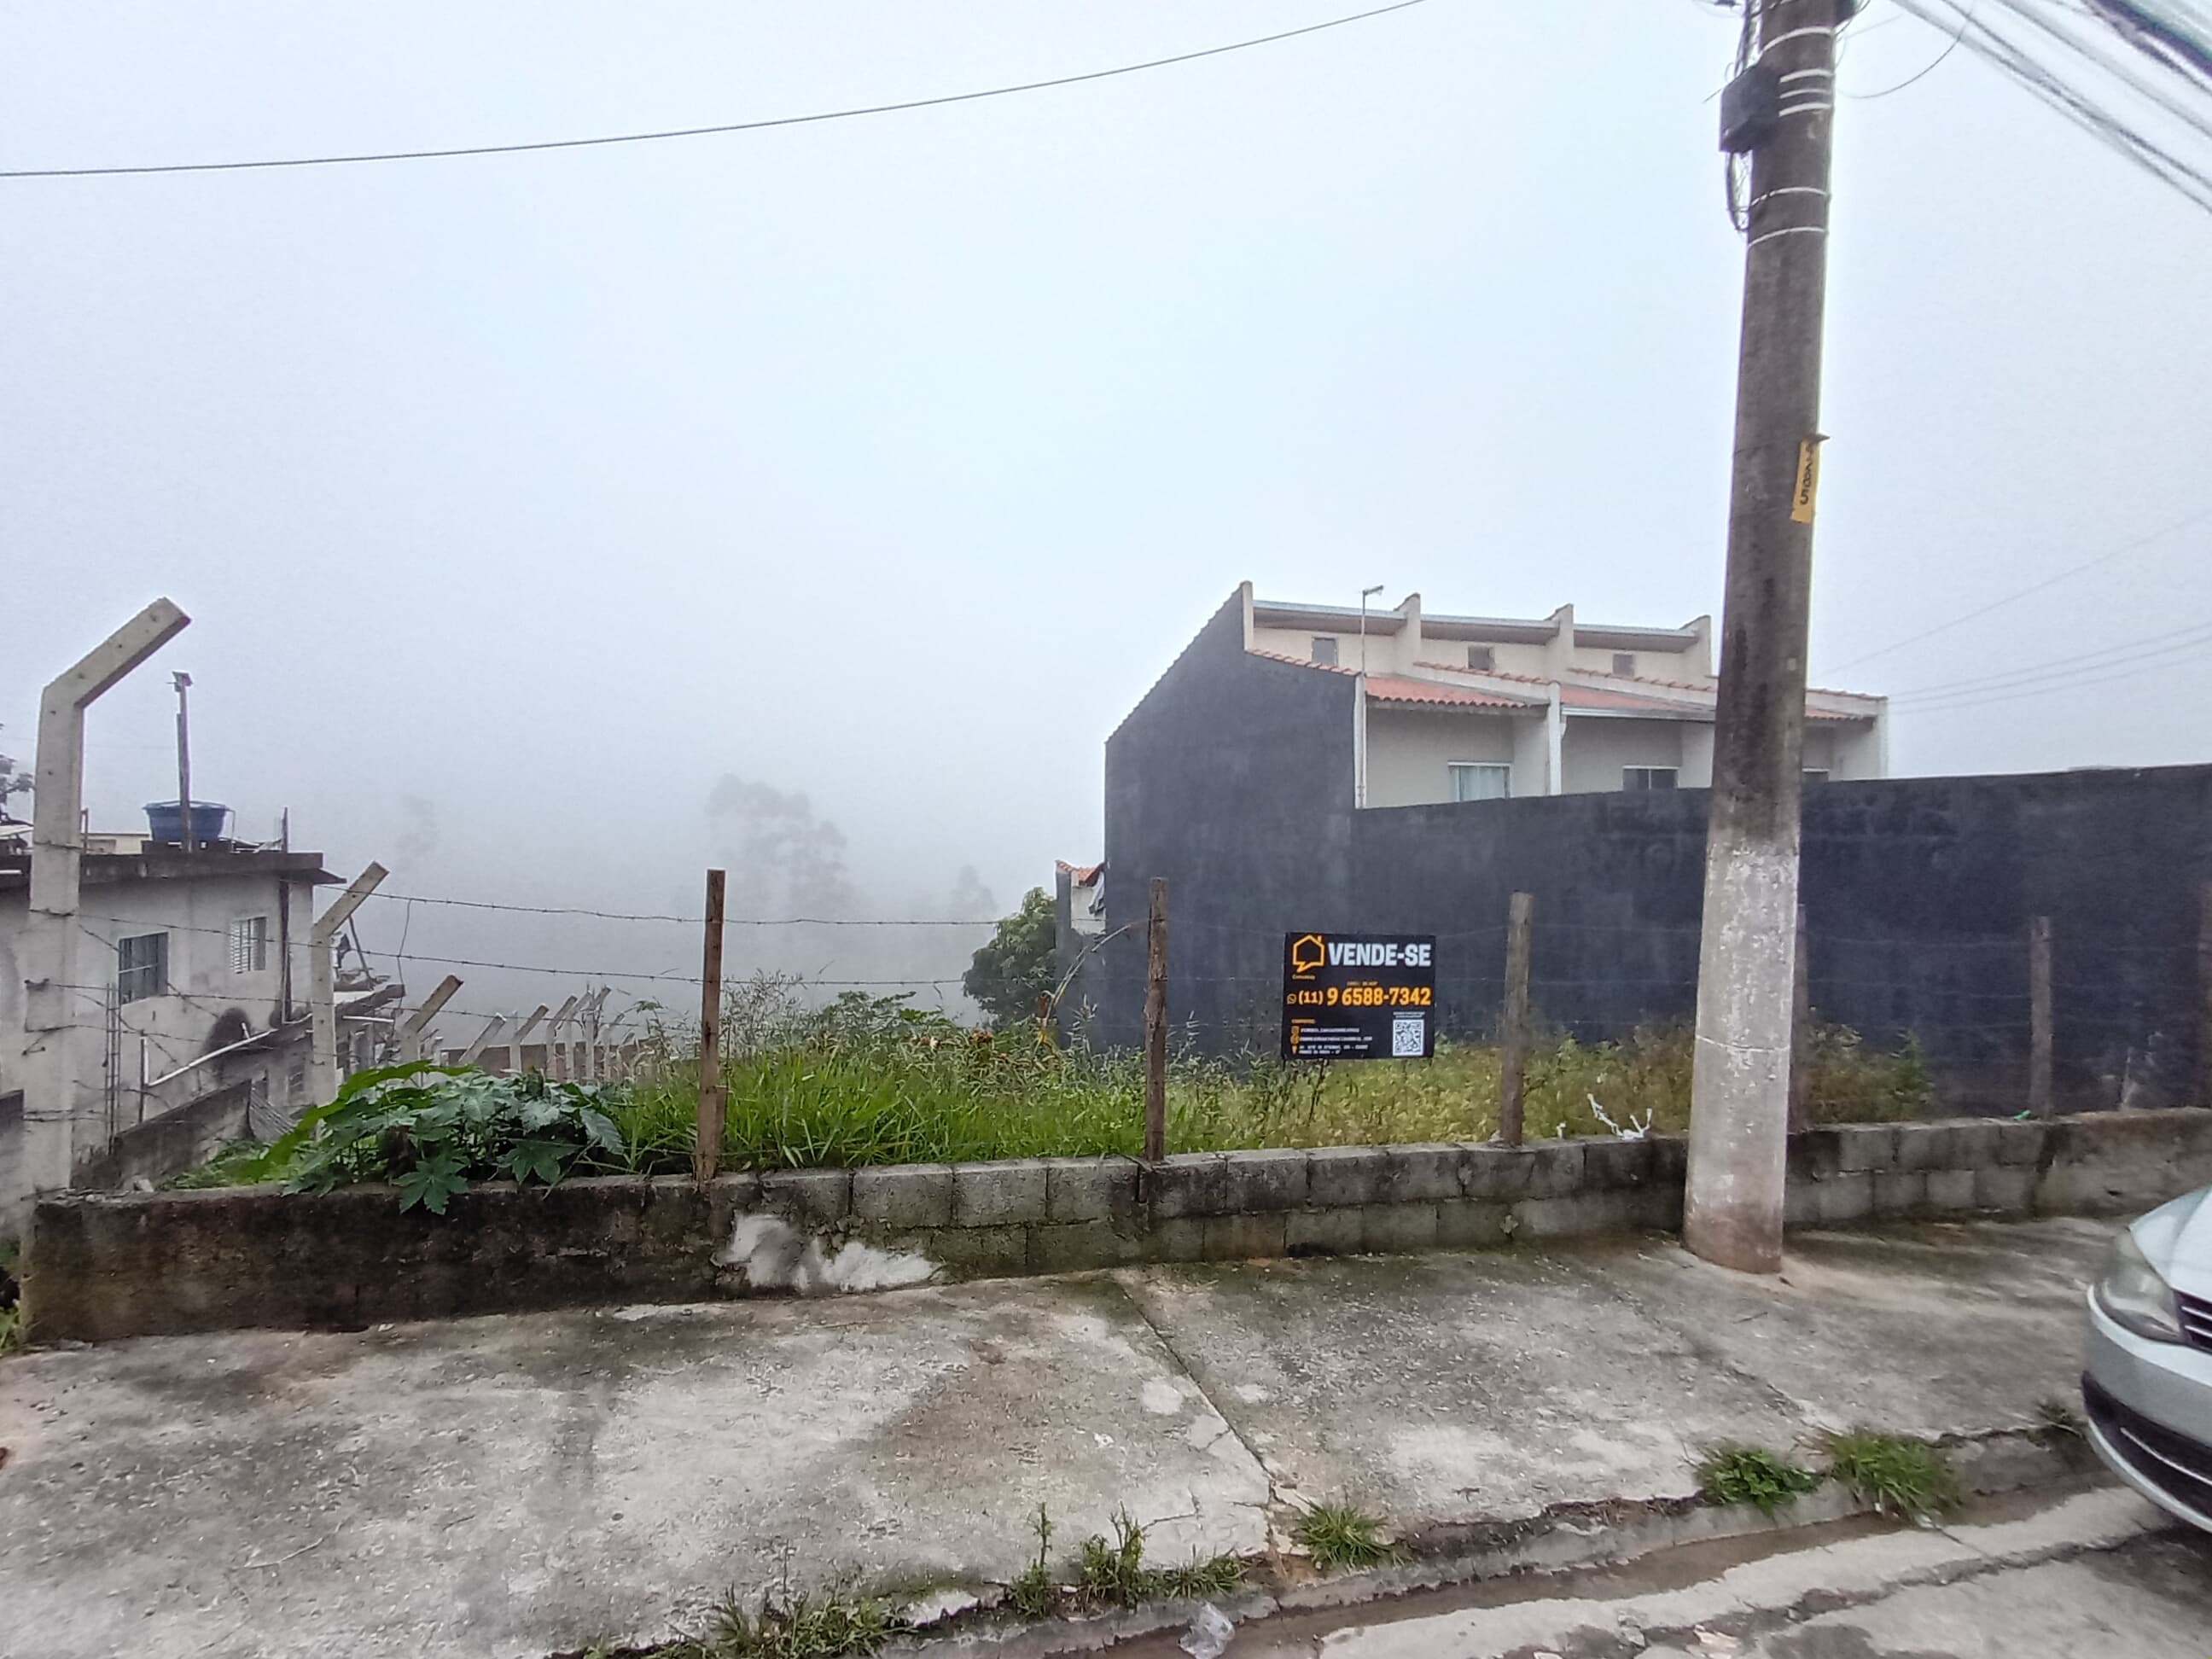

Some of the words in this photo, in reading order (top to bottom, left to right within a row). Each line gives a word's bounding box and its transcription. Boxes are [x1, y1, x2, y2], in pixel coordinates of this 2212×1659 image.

[1328, 942, 1432, 967] VENDE-SE
[1298, 990, 1324, 1005] (11)
[1326, 987, 1339, 1006] 9
[1342, 987, 1432, 1006] 6588-7342
